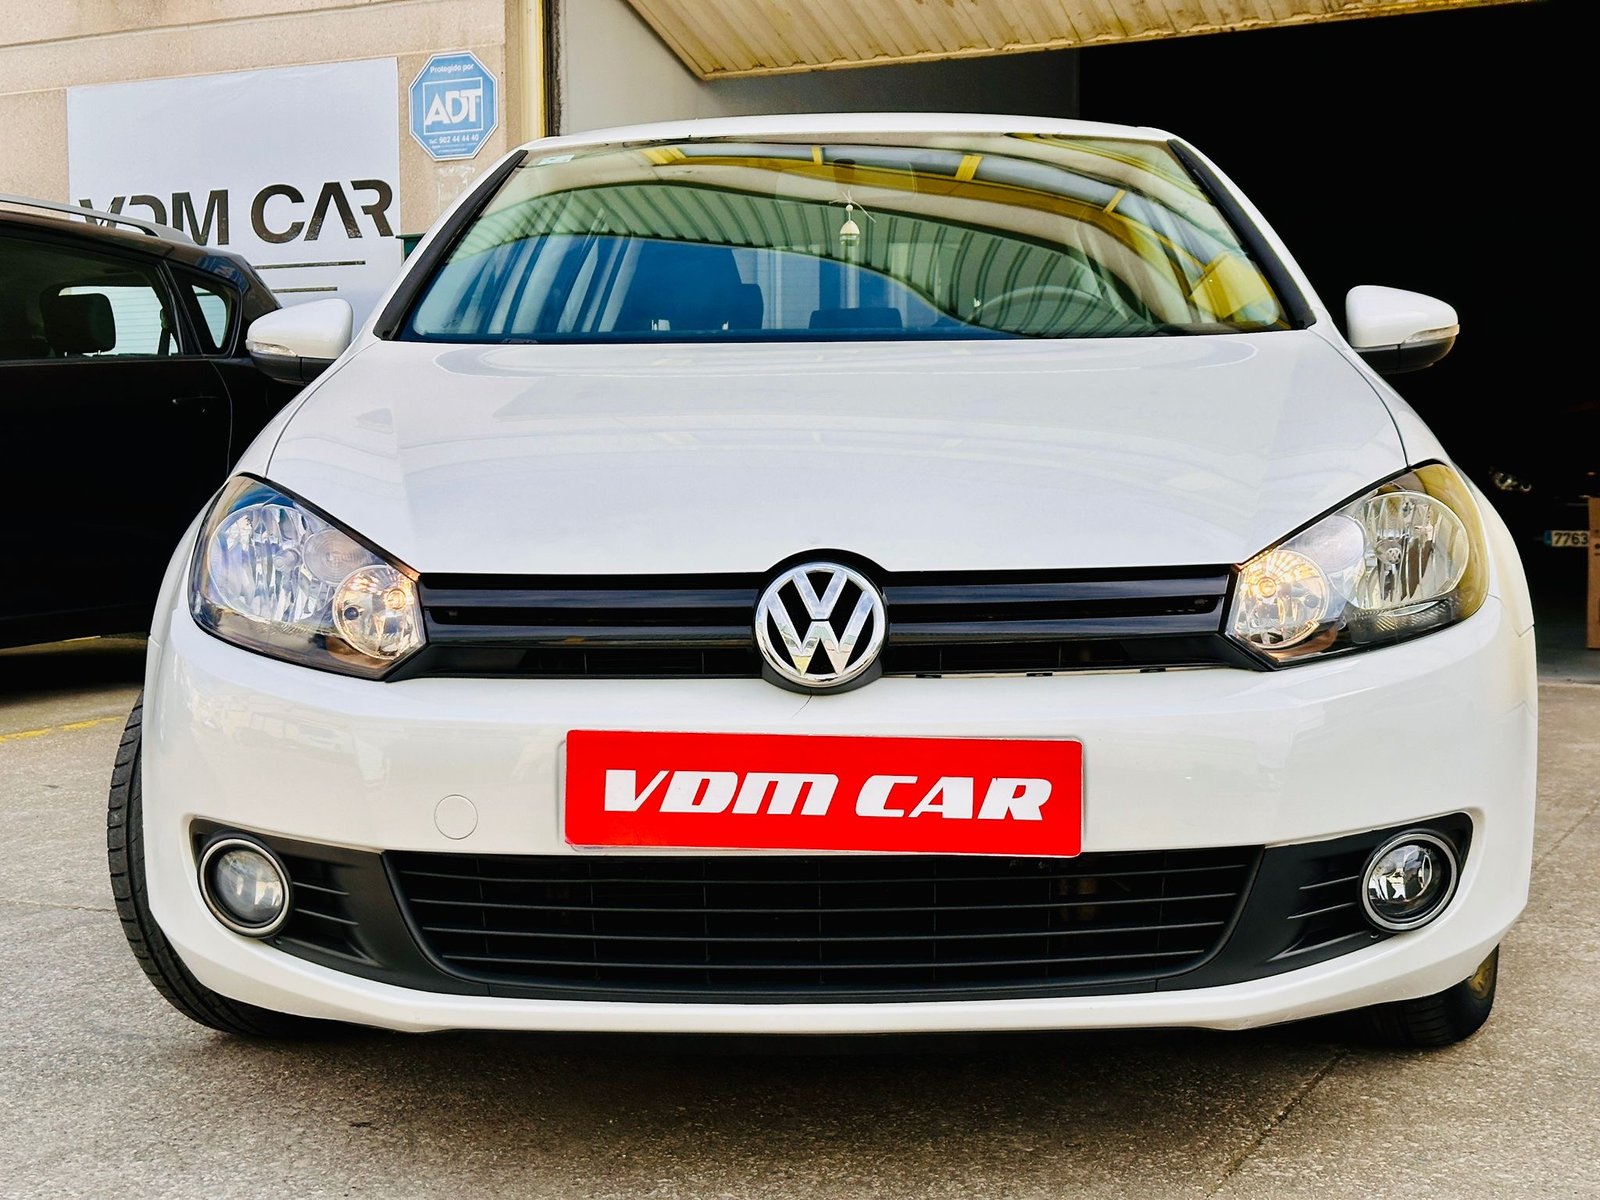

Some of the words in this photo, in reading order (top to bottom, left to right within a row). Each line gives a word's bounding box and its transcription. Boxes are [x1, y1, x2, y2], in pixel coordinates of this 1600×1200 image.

[430, 64, 462, 73] Protegido
[463, 63, 474, 71] por
[424, 88, 482, 126] ADT
[439, 136, 451, 144] 902
[462, 134, 470, 142] 44
[251, 179, 394, 244] CAR
[1554, 532, 1588, 545] 7763
[604, 769, 839, 816] VDM
[855, 775, 1052, 821] CAR
